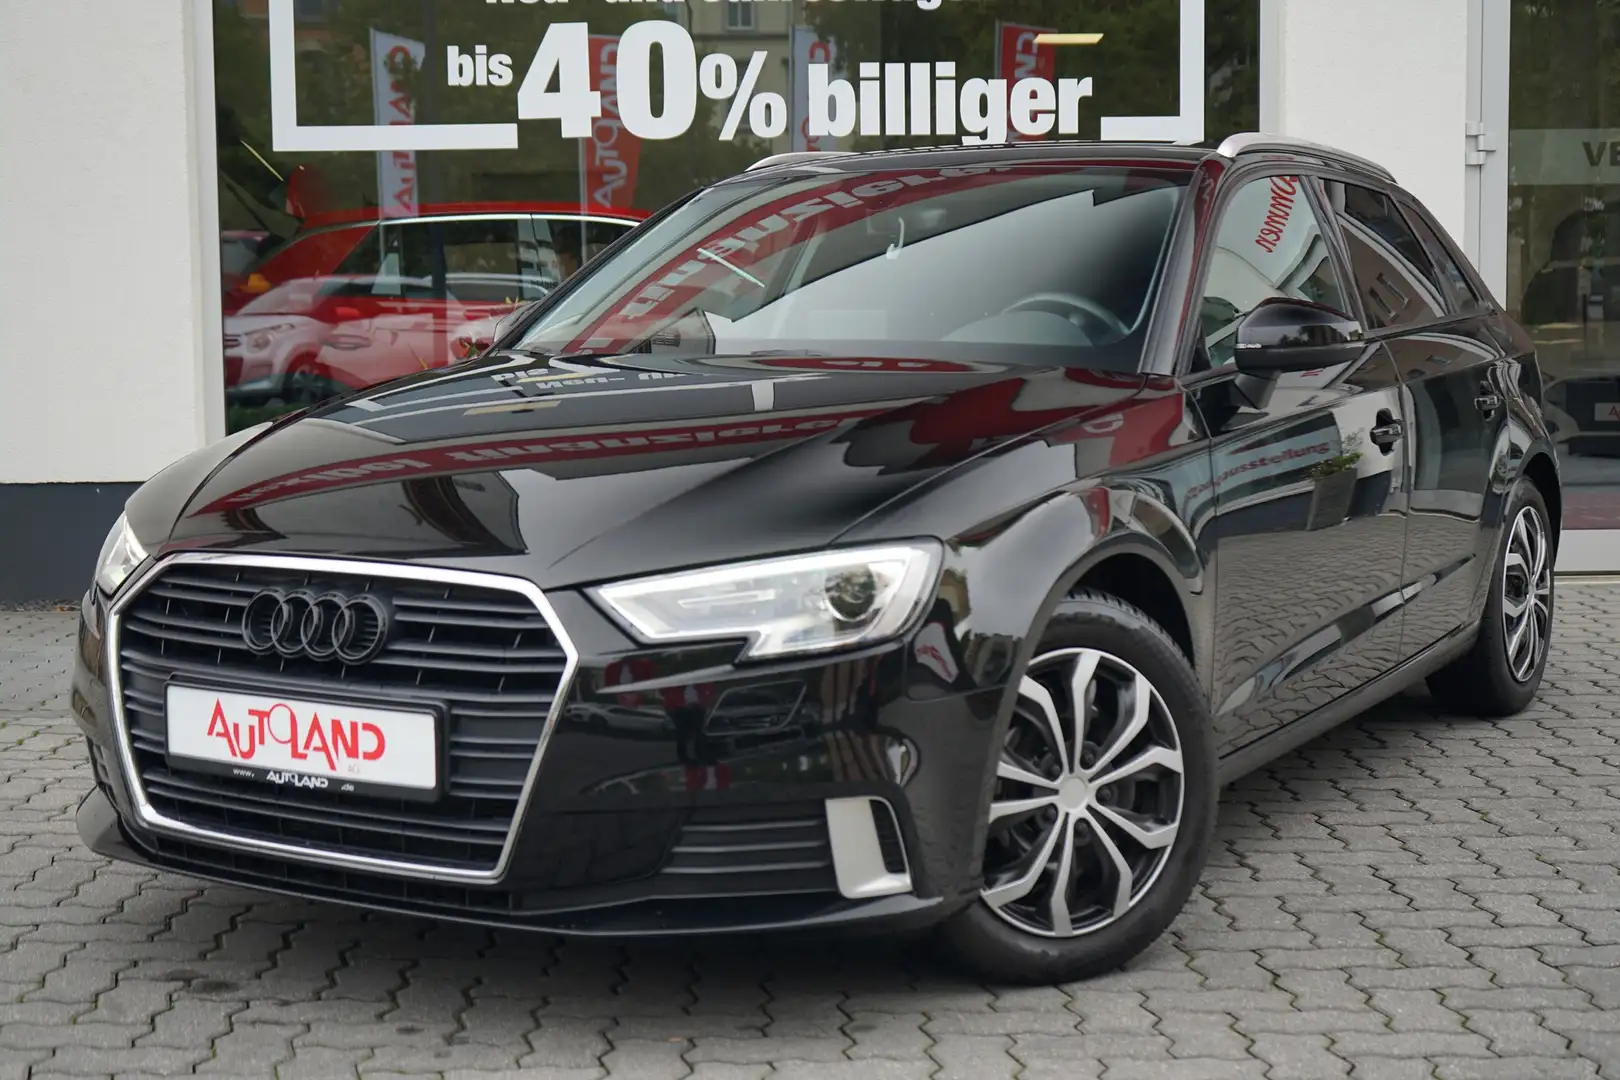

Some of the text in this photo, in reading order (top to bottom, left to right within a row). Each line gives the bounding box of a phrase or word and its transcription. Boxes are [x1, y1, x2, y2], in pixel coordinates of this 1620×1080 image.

[447, 45, 513, 86] bis
[517, 22, 787, 140] 40%
[808, 62, 1093, 146] billiger
[207, 698, 386, 771] AUTOLAND
[266, 770, 329, 789] AUTOLAND
